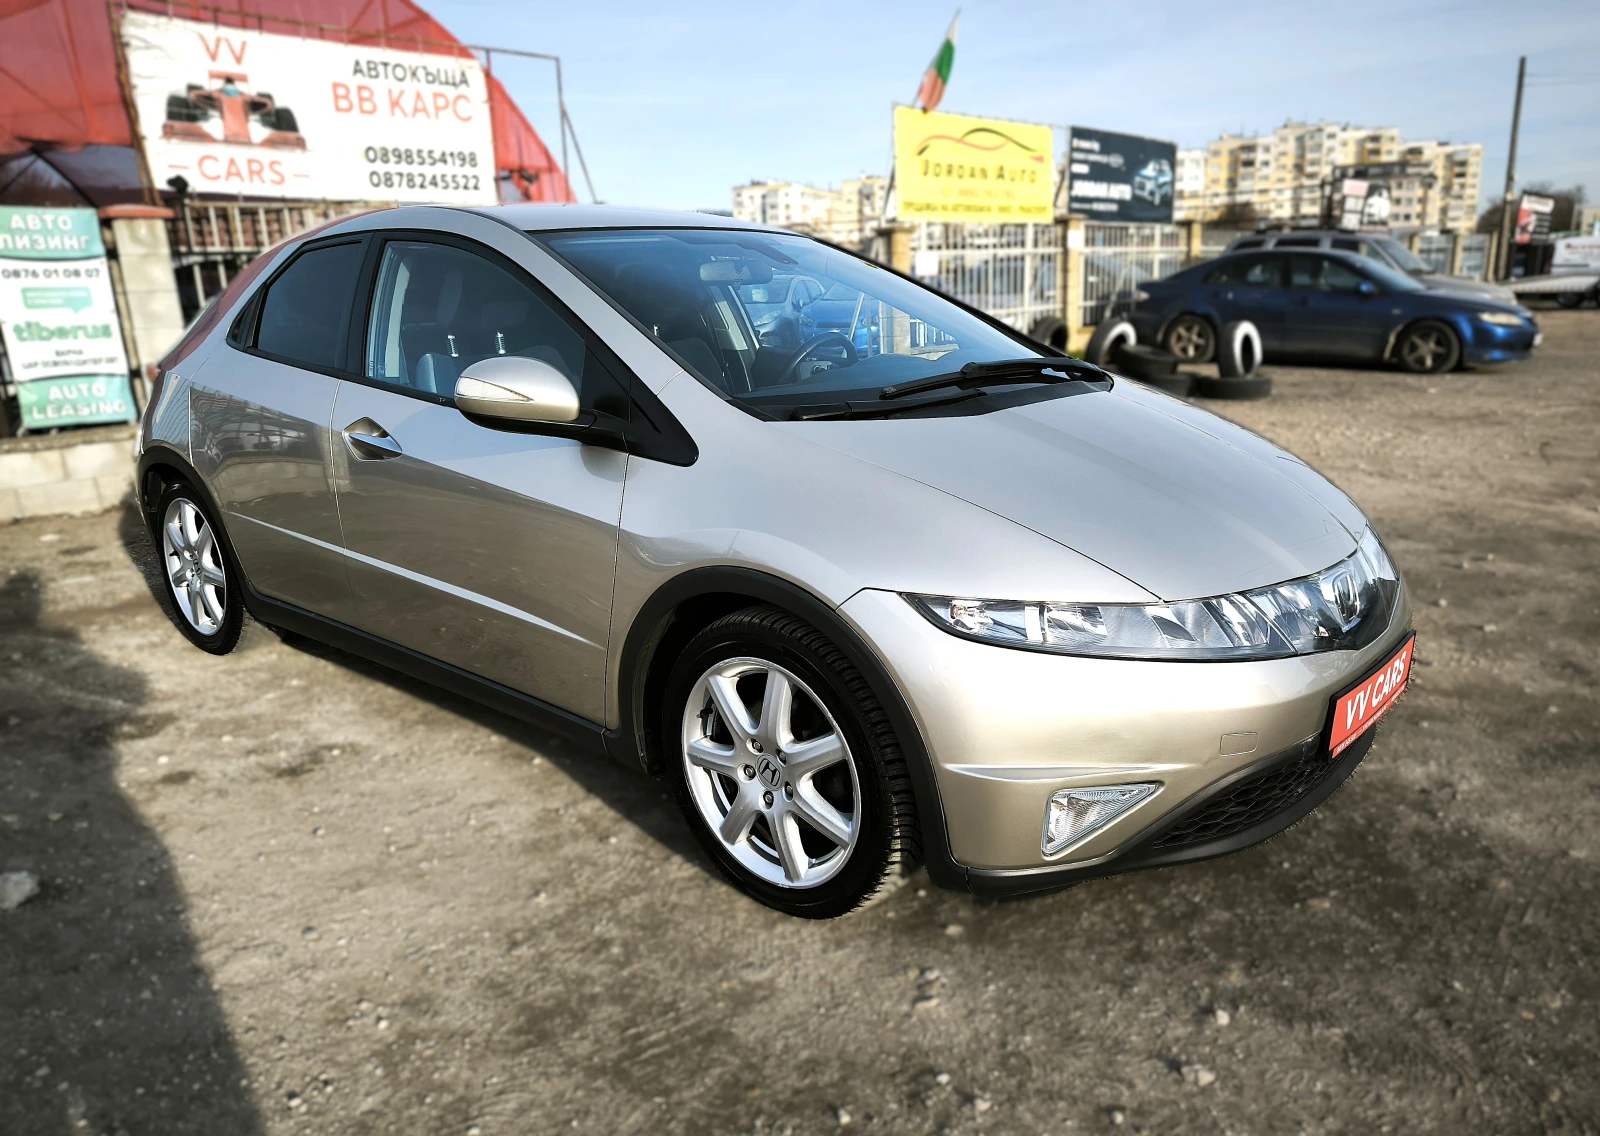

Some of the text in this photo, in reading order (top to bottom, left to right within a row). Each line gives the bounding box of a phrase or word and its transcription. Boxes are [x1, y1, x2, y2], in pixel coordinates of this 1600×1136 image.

[198, 33, 247, 66] VV
[352, 59, 470, 89] АВТОКЪЩА
[331, 81, 473, 123] ВВ КАРС
[197, 154, 286, 186] CARS
[364, 146, 478, 168] 0898554198
[368, 170, 480, 191] 0878245522
[10, 213, 74, 232] АВТО
[48, 381, 107, 402] AUTO
[31, 400, 128, 420] LEASING
[1345, 682, 1373, 731] VV
[1371, 650, 1408, 708] CARS
